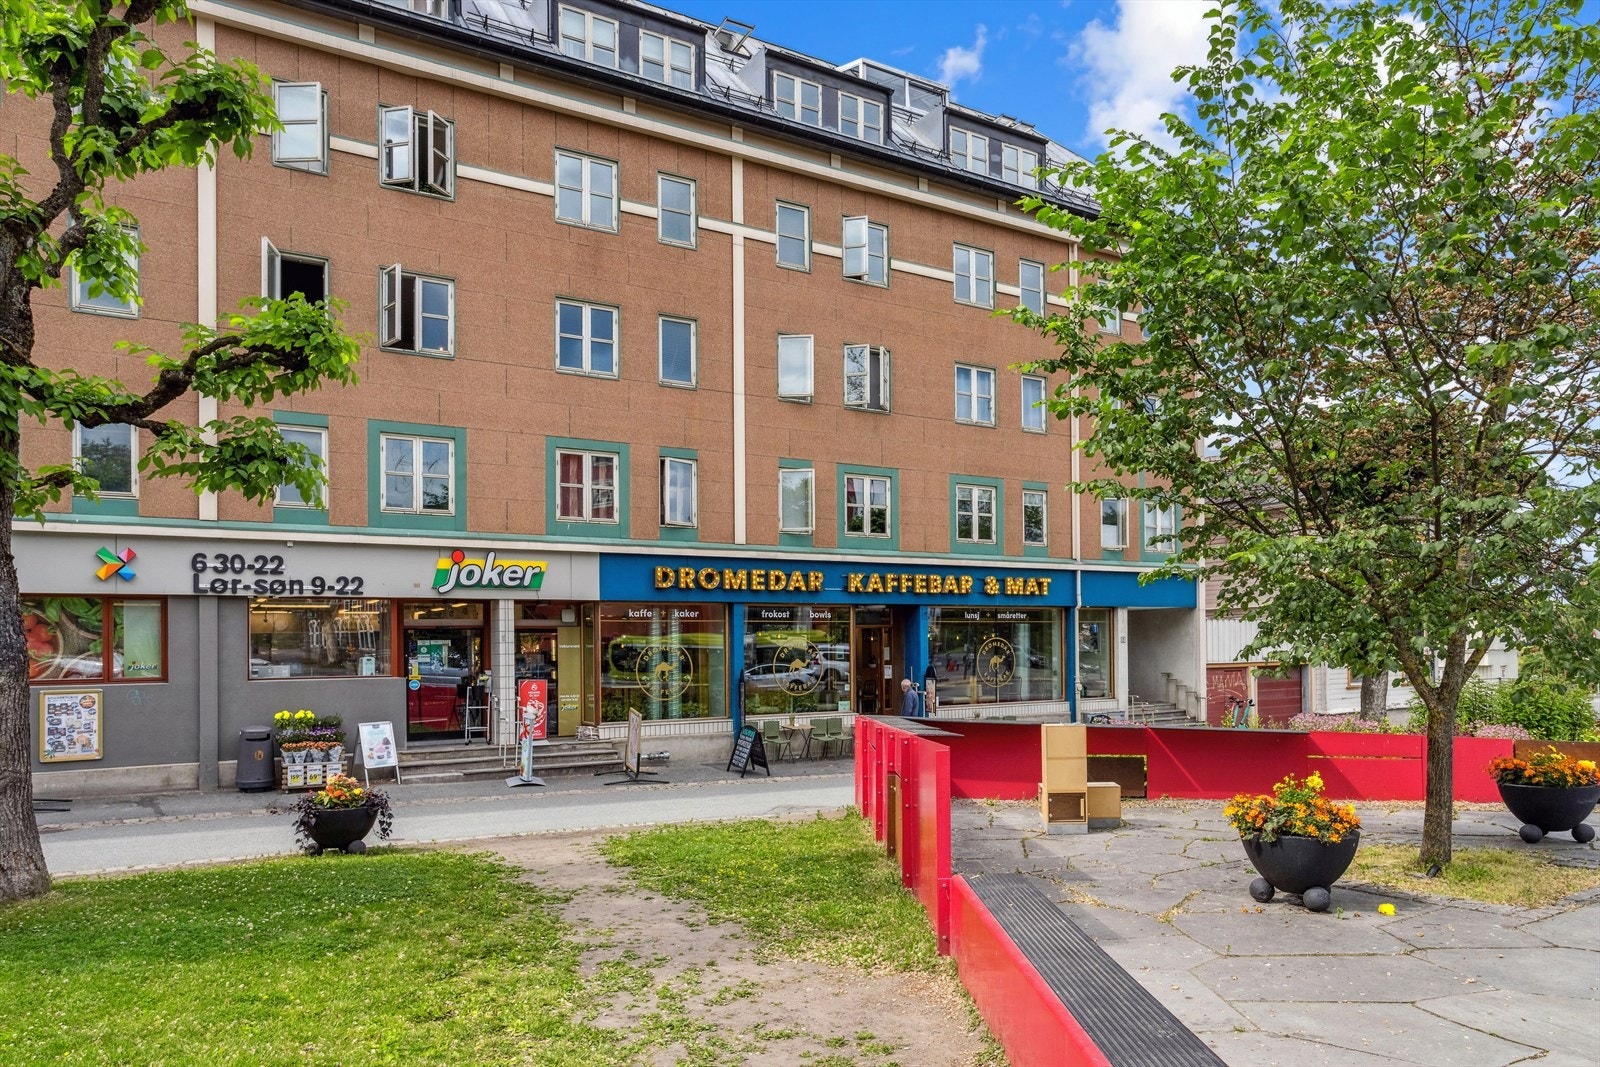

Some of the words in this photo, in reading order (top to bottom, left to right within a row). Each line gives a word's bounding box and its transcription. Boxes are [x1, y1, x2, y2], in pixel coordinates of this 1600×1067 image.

[191, 553, 207, 573] 6
[213, 554, 284, 575] 30-22
[438, 549, 541, 594] joker
[193, 573, 304, 595] Lør-søn
[311, 576, 364, 595] 9-22
[654, 566, 824, 591] DROMEDAR
[848, 573, 973, 594] KAFFEBAR
[984, 576, 1000, 595] &
[1004, 577, 1051, 595] MAT
[628, 609, 653, 618] kaffe
[674, 609, 699, 618] kaker
[761, 610, 790, 619] frokost
[809, 610, 832, 619] bowls
[964, 611, 980, 620] lunsj
[997, 611, 1027, 619] småretter
[981, 641, 1010, 655] DROMEDAR
[128, 661, 156, 672] joker
